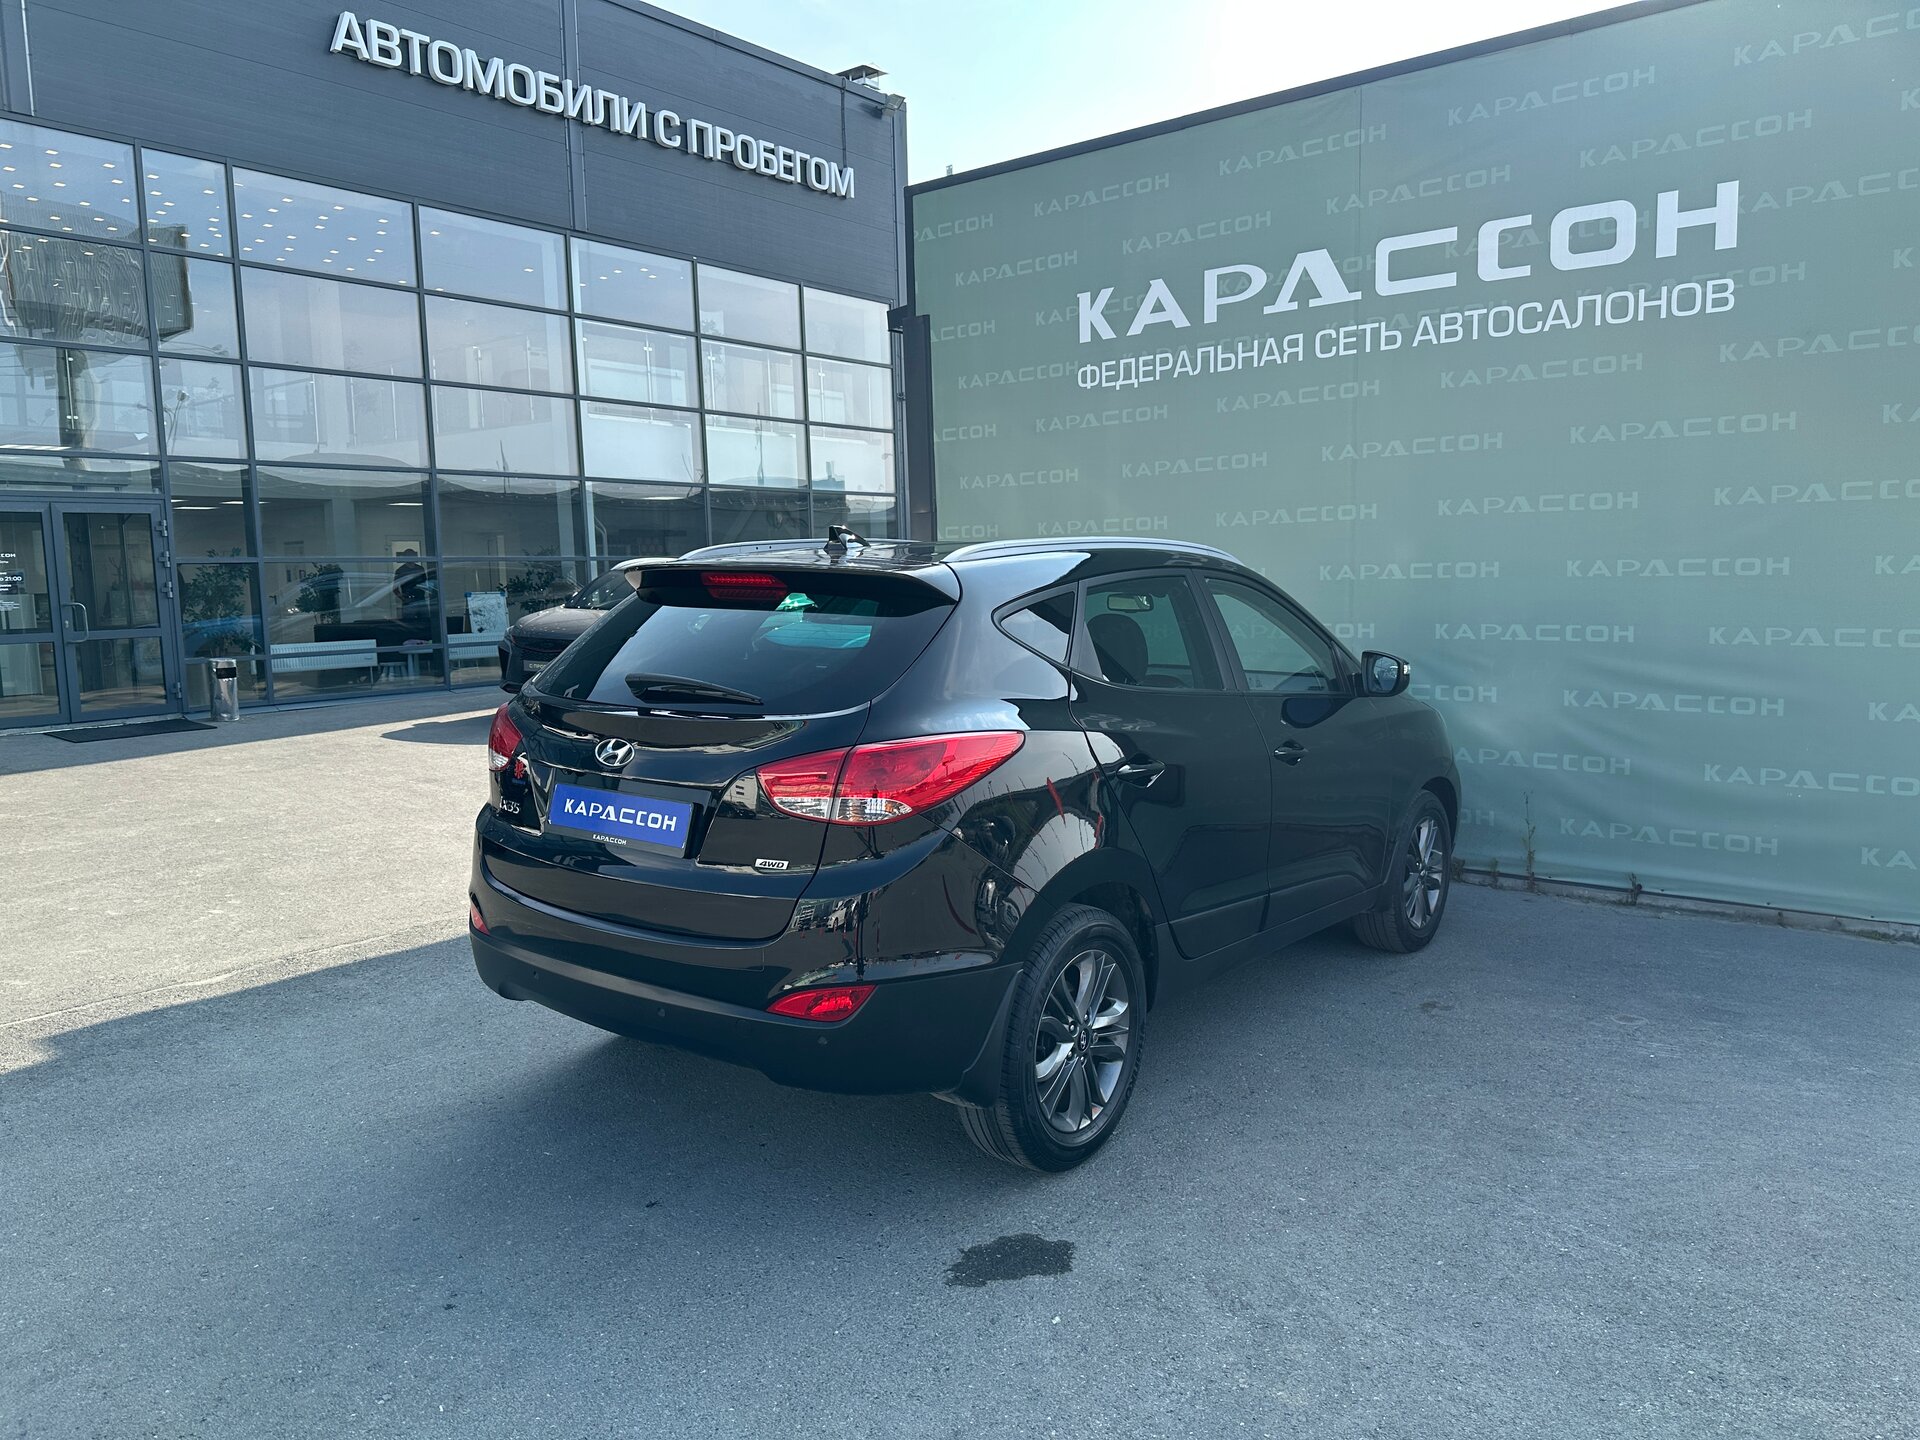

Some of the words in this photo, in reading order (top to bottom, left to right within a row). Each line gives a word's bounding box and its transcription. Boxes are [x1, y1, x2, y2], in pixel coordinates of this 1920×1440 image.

[330, 11, 647, 139] АВТОМОБИЛИ
[654, 109, 681, 149] С
[687, 118, 855, 199] ПРОБЕГОМ
[1076, 180, 1739, 344] КАРАССОН
[1077, 333, 1304, 390] ФЕДЕРАЛЬНАЯ
[1314, 320, 1404, 360] СЕТЬ
[1412, 278, 1736, 348] АВТОСАЛОНОВ
[564, 798, 677, 832] КАРАССОН
[759, 860, 785, 868] 4WD
